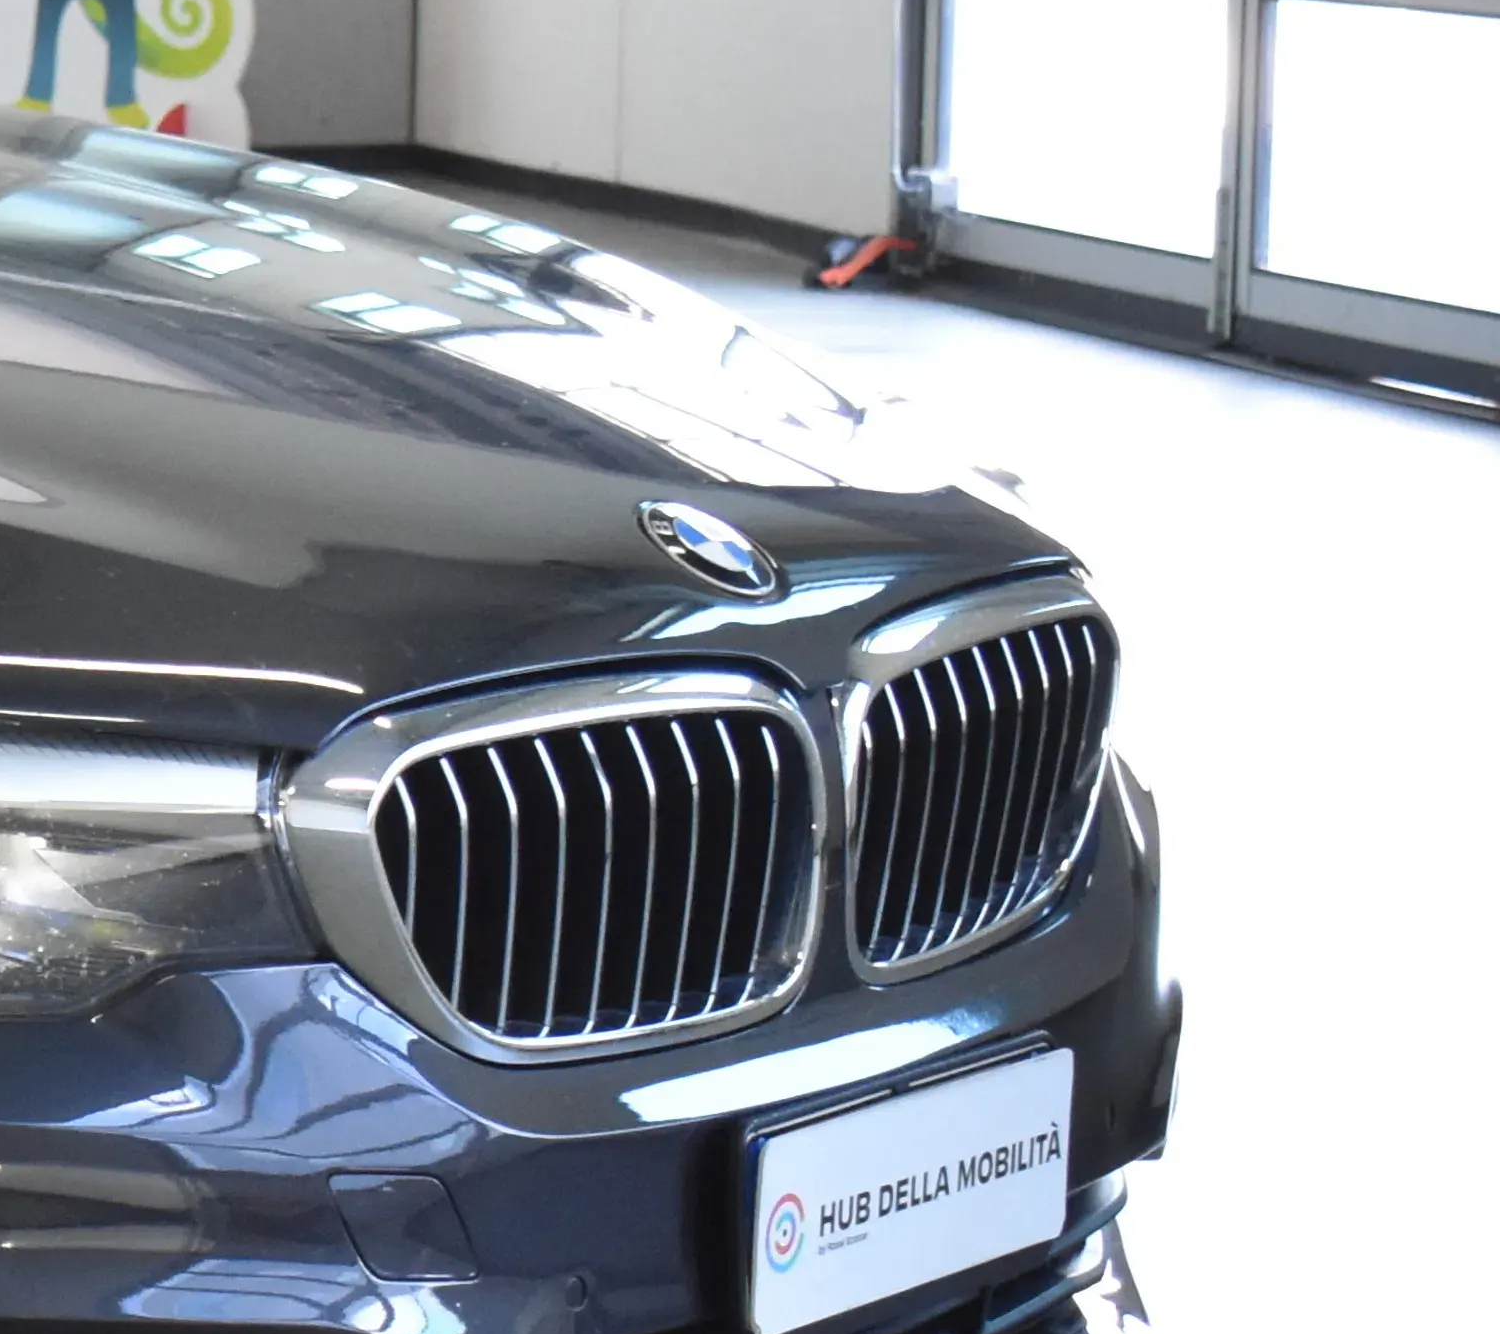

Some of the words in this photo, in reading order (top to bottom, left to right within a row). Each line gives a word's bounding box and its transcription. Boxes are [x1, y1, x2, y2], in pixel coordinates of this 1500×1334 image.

[819, 1190, 871, 1238] HUB
[878, 1165, 951, 1218] DELLA
[956, 1120, 1062, 1193] MOBILITÀ
